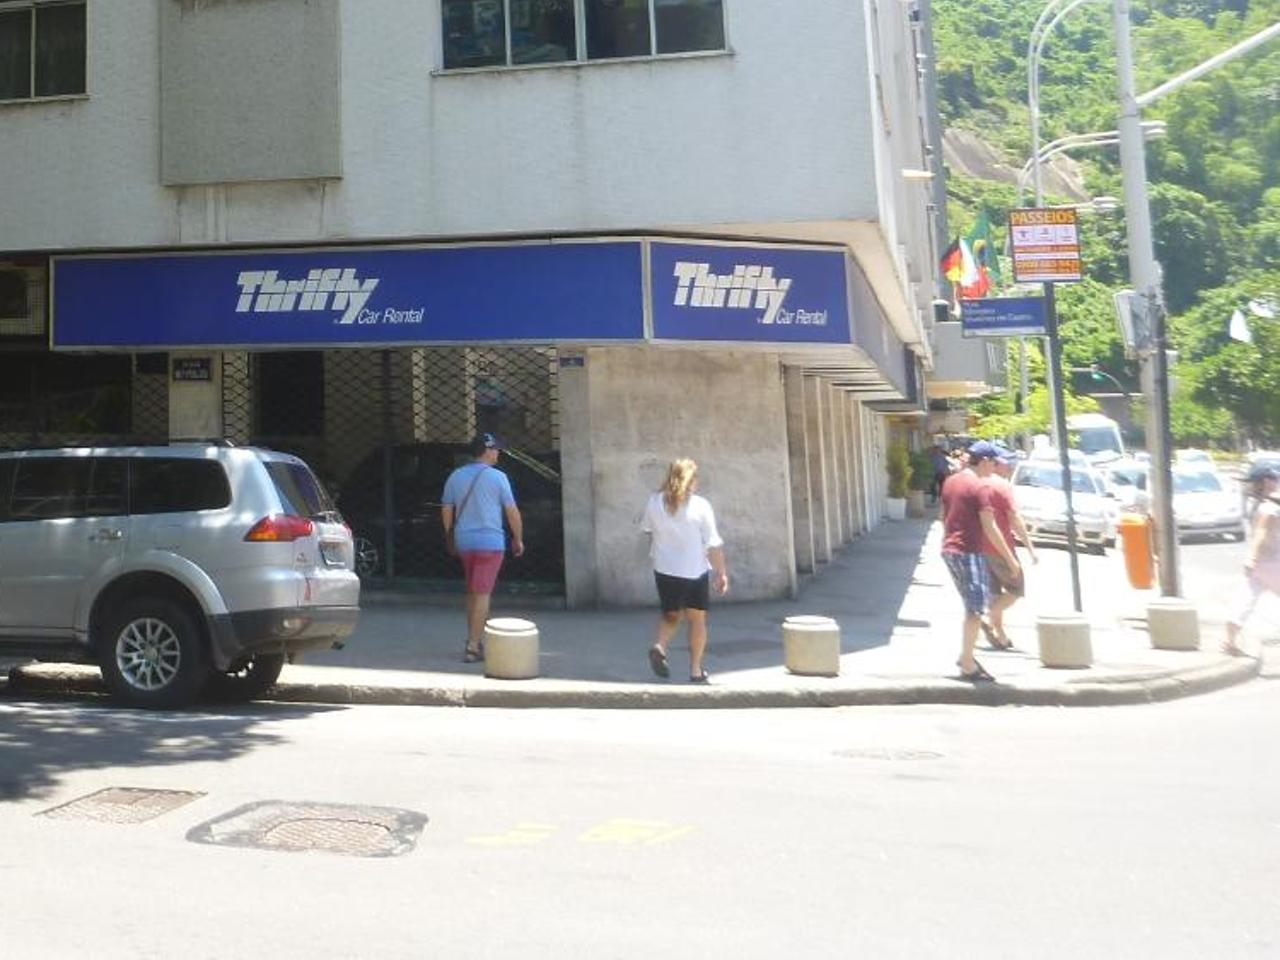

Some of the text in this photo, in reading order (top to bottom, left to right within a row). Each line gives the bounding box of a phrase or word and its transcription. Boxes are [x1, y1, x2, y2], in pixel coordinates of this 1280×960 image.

[1011, 210, 1075, 225] PASSEIOS
[235, 268, 380, 325] Thrifty
[673, 261, 793, 324] Thrifty
[357, 308, 425, 325] Car Rental
[776, 309, 827, 326] Car Rental
